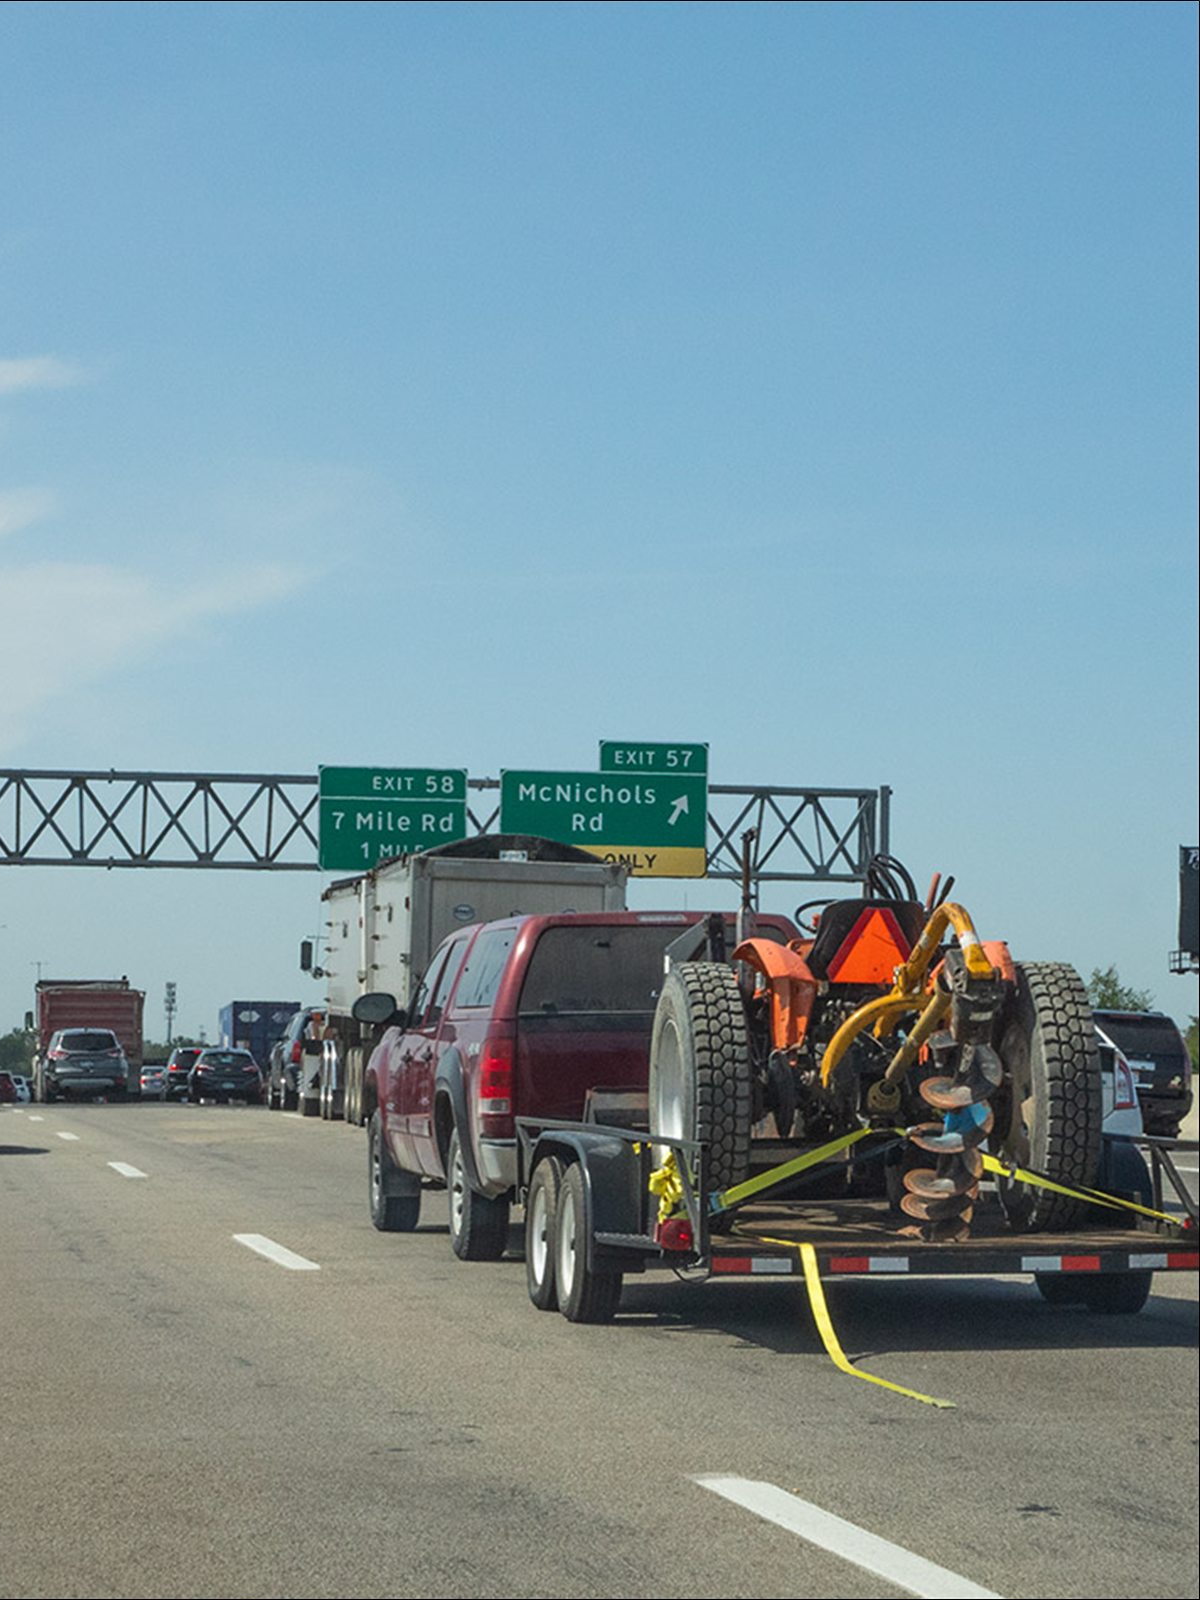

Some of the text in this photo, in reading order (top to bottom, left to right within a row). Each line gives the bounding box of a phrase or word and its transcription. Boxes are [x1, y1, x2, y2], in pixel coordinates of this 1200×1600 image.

[614, 750, 693, 767] EXIT 57
[372, 776, 455, 793] EXIT 58
[519, 783, 656, 805] McNichols
[331, 812, 454, 833] 7 Mile Rd
[572, 813, 603, 832] Rd
[360, 841, 369, 859] 1
[604, 853, 657, 869] ONLY
